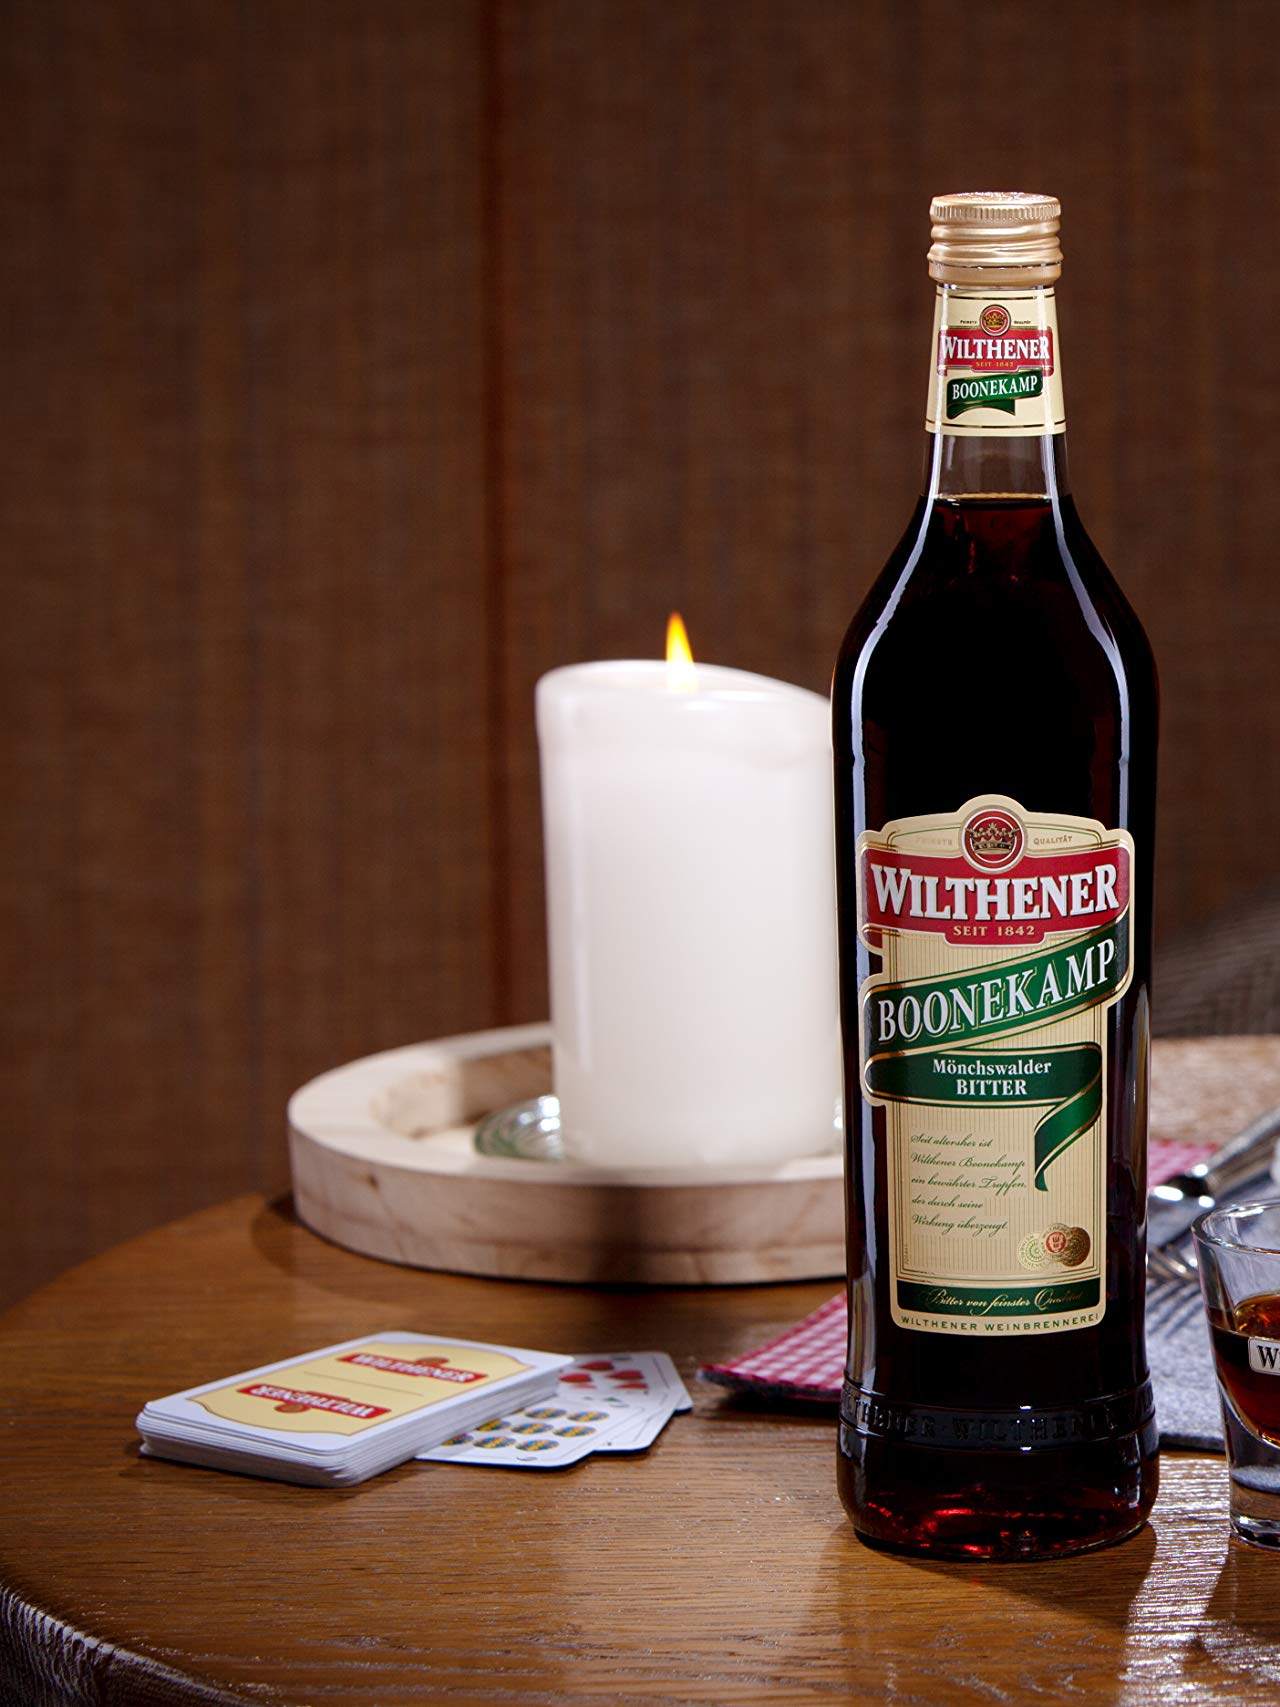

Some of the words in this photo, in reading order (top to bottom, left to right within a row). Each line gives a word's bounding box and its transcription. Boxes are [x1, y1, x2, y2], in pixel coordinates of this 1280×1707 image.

[940, 335, 1050, 359] WILTHENER
[952, 375, 1038, 400] BOONEKAMP
[1033, 834, 1073, 846] QUALITÄT
[870, 863, 1120, 922] WILTHENER
[953, 925, 988, 937] SEIT
[997, 925, 1035, 936] 1842
[878, 938, 1116, 1043] BOONEKAMP
[932, 1058, 1052, 1076] Mönchswalder
[956, 1079, 1028, 1096] BITTER
[911, 1133, 933, 1145] Seit
[978, 1139, 993, 1147] ist
[911, 1152, 957, 1167] Wilthener
[958, 1154, 1026, 1175] Boonekamp
[911, 1175, 926, 1185] ein
[927, 1172, 976, 1188] bewährter
[911, 1194, 926, 1205] der
[927, 1194, 956, 1208] durch
[957, 1200, 984, 1209] seine
[911, 1213, 955, 1236] Wirkung
[925, 1287, 964, 1306] Bitter
[970, 1293, 1030, 1316] feinster
[901, 1314, 977, 1331] WILTHENER
[984, 1312, 1100, 1332] WEINBRENNEREI
[250, 1384, 376, 1418] WILTHENER
